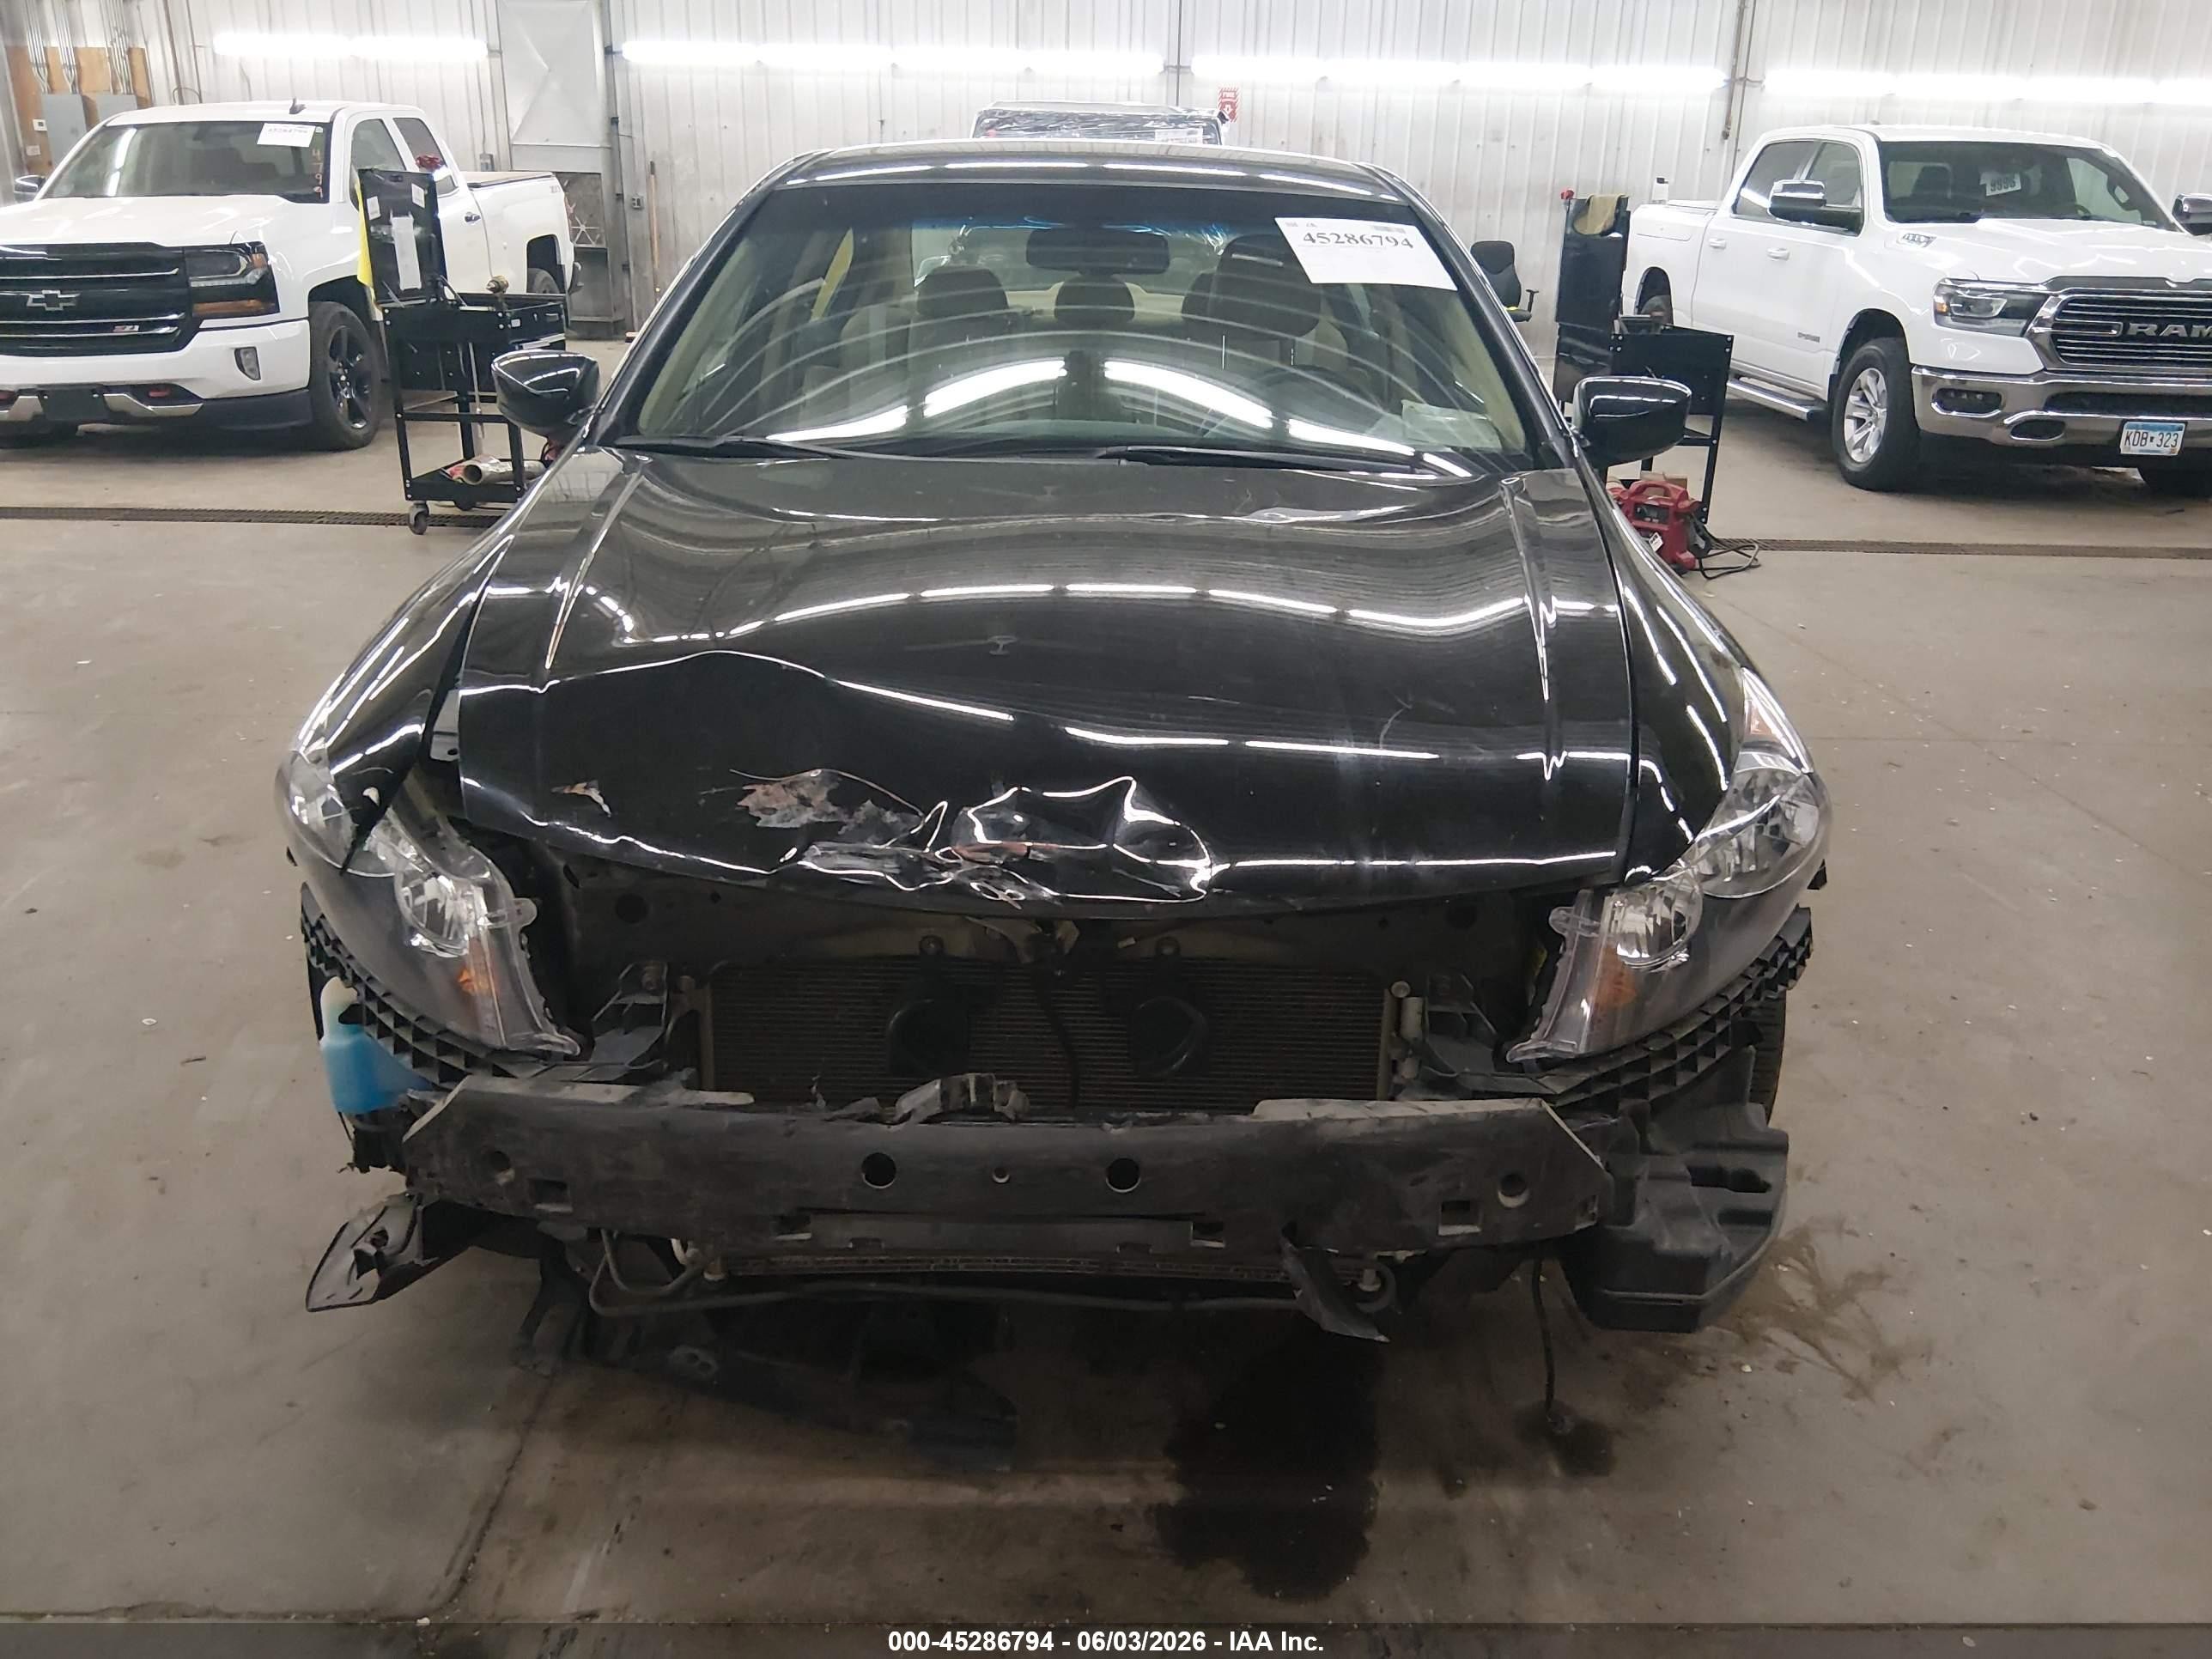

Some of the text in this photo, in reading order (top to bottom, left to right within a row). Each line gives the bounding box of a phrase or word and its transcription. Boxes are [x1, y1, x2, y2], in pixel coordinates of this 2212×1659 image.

[1303, 232, 1413, 249] 45286794
[2126, 322, 2212, 337] RAM
[2156, 432, 2179, 447] 323
